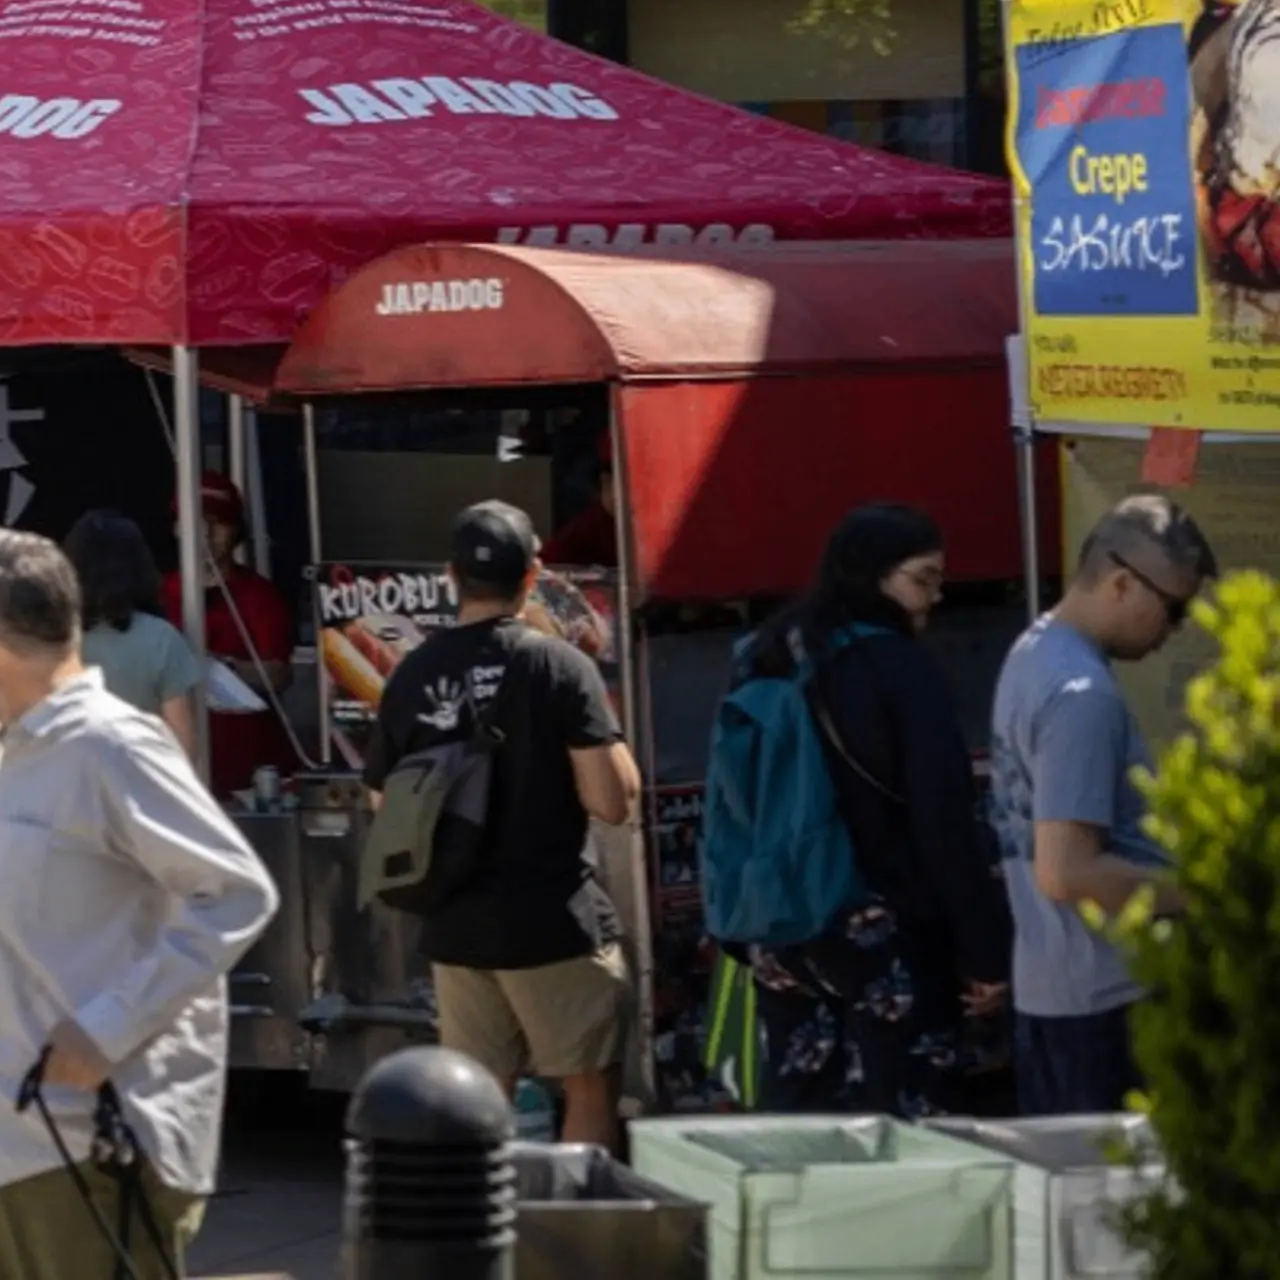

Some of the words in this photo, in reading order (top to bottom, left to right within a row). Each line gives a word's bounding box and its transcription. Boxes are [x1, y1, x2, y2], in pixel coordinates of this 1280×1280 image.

[297, 76, 619, 125] JAPADOG
[1068, 143, 1149, 206] Crepe
[1041, 212, 1186, 278] SASUKE
[375, 276, 505, 316] JAPADOG
[319, 572, 460, 620] KUROBUT
